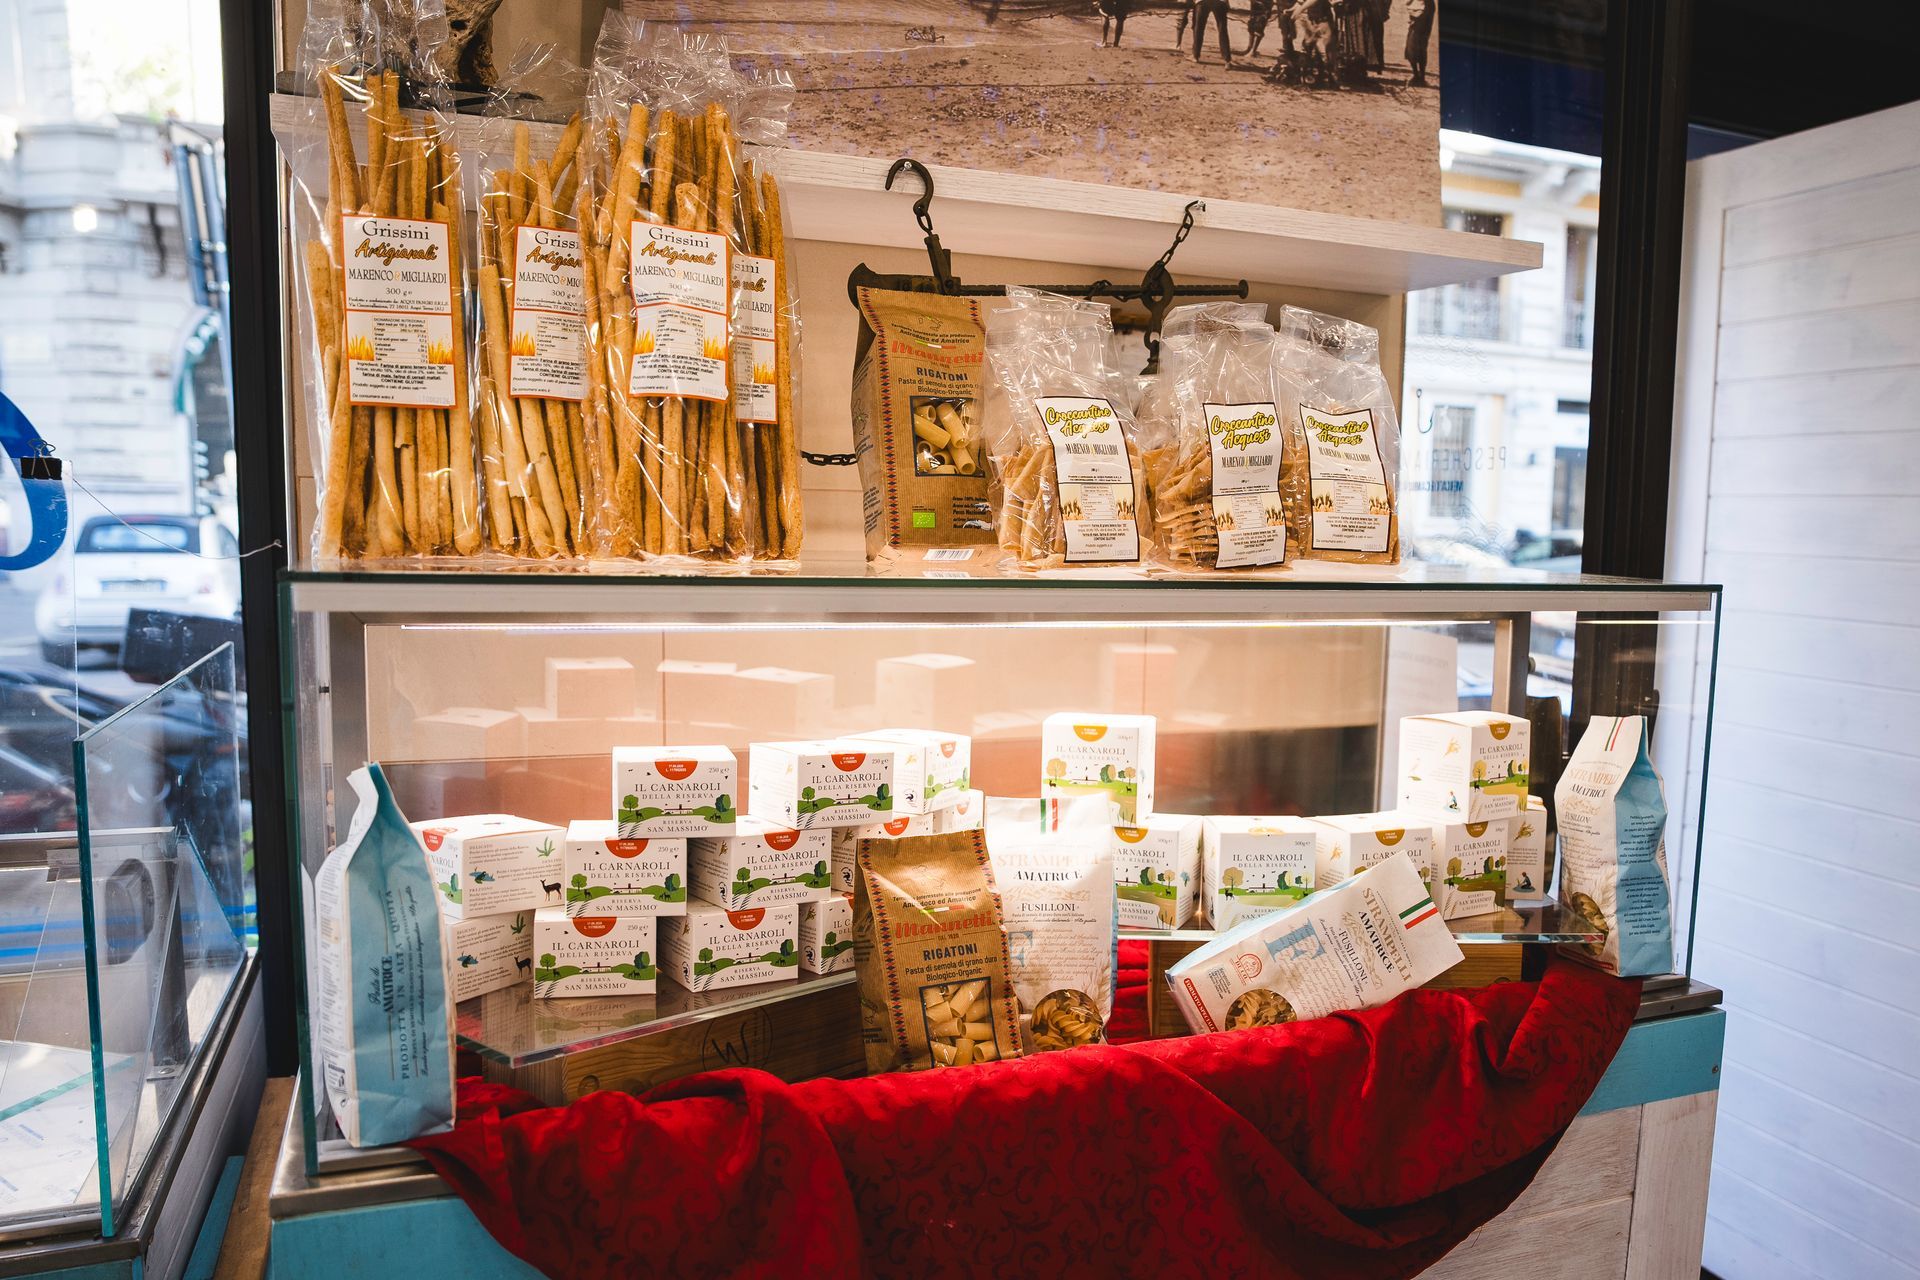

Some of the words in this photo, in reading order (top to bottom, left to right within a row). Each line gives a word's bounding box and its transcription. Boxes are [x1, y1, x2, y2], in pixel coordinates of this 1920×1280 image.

[362, 220, 430, 240] Grissini
[649, 226, 709, 248] Grissini
[355, 238, 439, 266] Artigianali
[526, 246, 582, 272] Artigian
[641, 241, 717, 266] Artigianali
[734, 260, 760, 274] sini
[349, 269, 393, 281] MARENCO
[402, 271, 446, 283] MIGLIARDI
[519, 272, 559, 284] MARENCO
[635, 266, 676, 277] MARENCO
[683, 272, 724, 287] MIGLIARDI
[891, 341, 983, 363] Mannetti
[917, 367, 968, 380] RIGATONI
[898, 377, 916, 385] Pasta
[926, 380, 946, 388] semola
[918, 386, 972, 395] Biologico-Organic
[1045, 405, 1111, 425] Croccantine
[1211, 412, 1274, 435] Croccantine
[1306, 416, 1368, 434] Croccantine
[1222, 428, 1270, 451] Acquesi
[1316, 430, 1363, 447] Acquesi
[1069, 746, 1126, 755] CARNAROLI
[1488, 744, 1523, 754] CARNAROLI
[825, 773, 882, 783] CARNAROLI
[635, 784, 646, 792] IL
[650, 783, 720, 791] CARNAROLI
[1464, 840, 1500, 851] CARNAROLI
[760, 850, 819, 864] CARNAROLI
[600, 862, 670, 871] CARNAROLI
[1014, 870, 1082, 881] AMATRICE
[774, 892, 807, 900] MASSIMO
[385, 890, 400, 933] QUOTA
[1022, 903, 1076, 912] FUSILLONI
[896, 911, 992, 938] Mannetti
[724, 929, 785, 943] CARNAROLI
[1359, 911, 1394, 973] AMATRICE
[1362, 888, 1412, 982] STRAMPELLI
[552, 942, 564, 950] IL
[568, 940, 640, 950] CARNAROLI
[923, 943, 978, 960] RIGATONI
[395, 943, 405, 975] ALTA
[1339, 931, 1368, 980] FUSILLONI
[933, 962, 956, 971] semola
[966, 958, 983, 968] grano
[738, 971, 773, 980] MASSIMO
[926, 967, 982, 981] Biologico-Organic
[382, 956, 394, 1013] AMATRICE
[397, 985, 405, 997] IN
[397, 1007, 410, 1080] PRODOTTA
